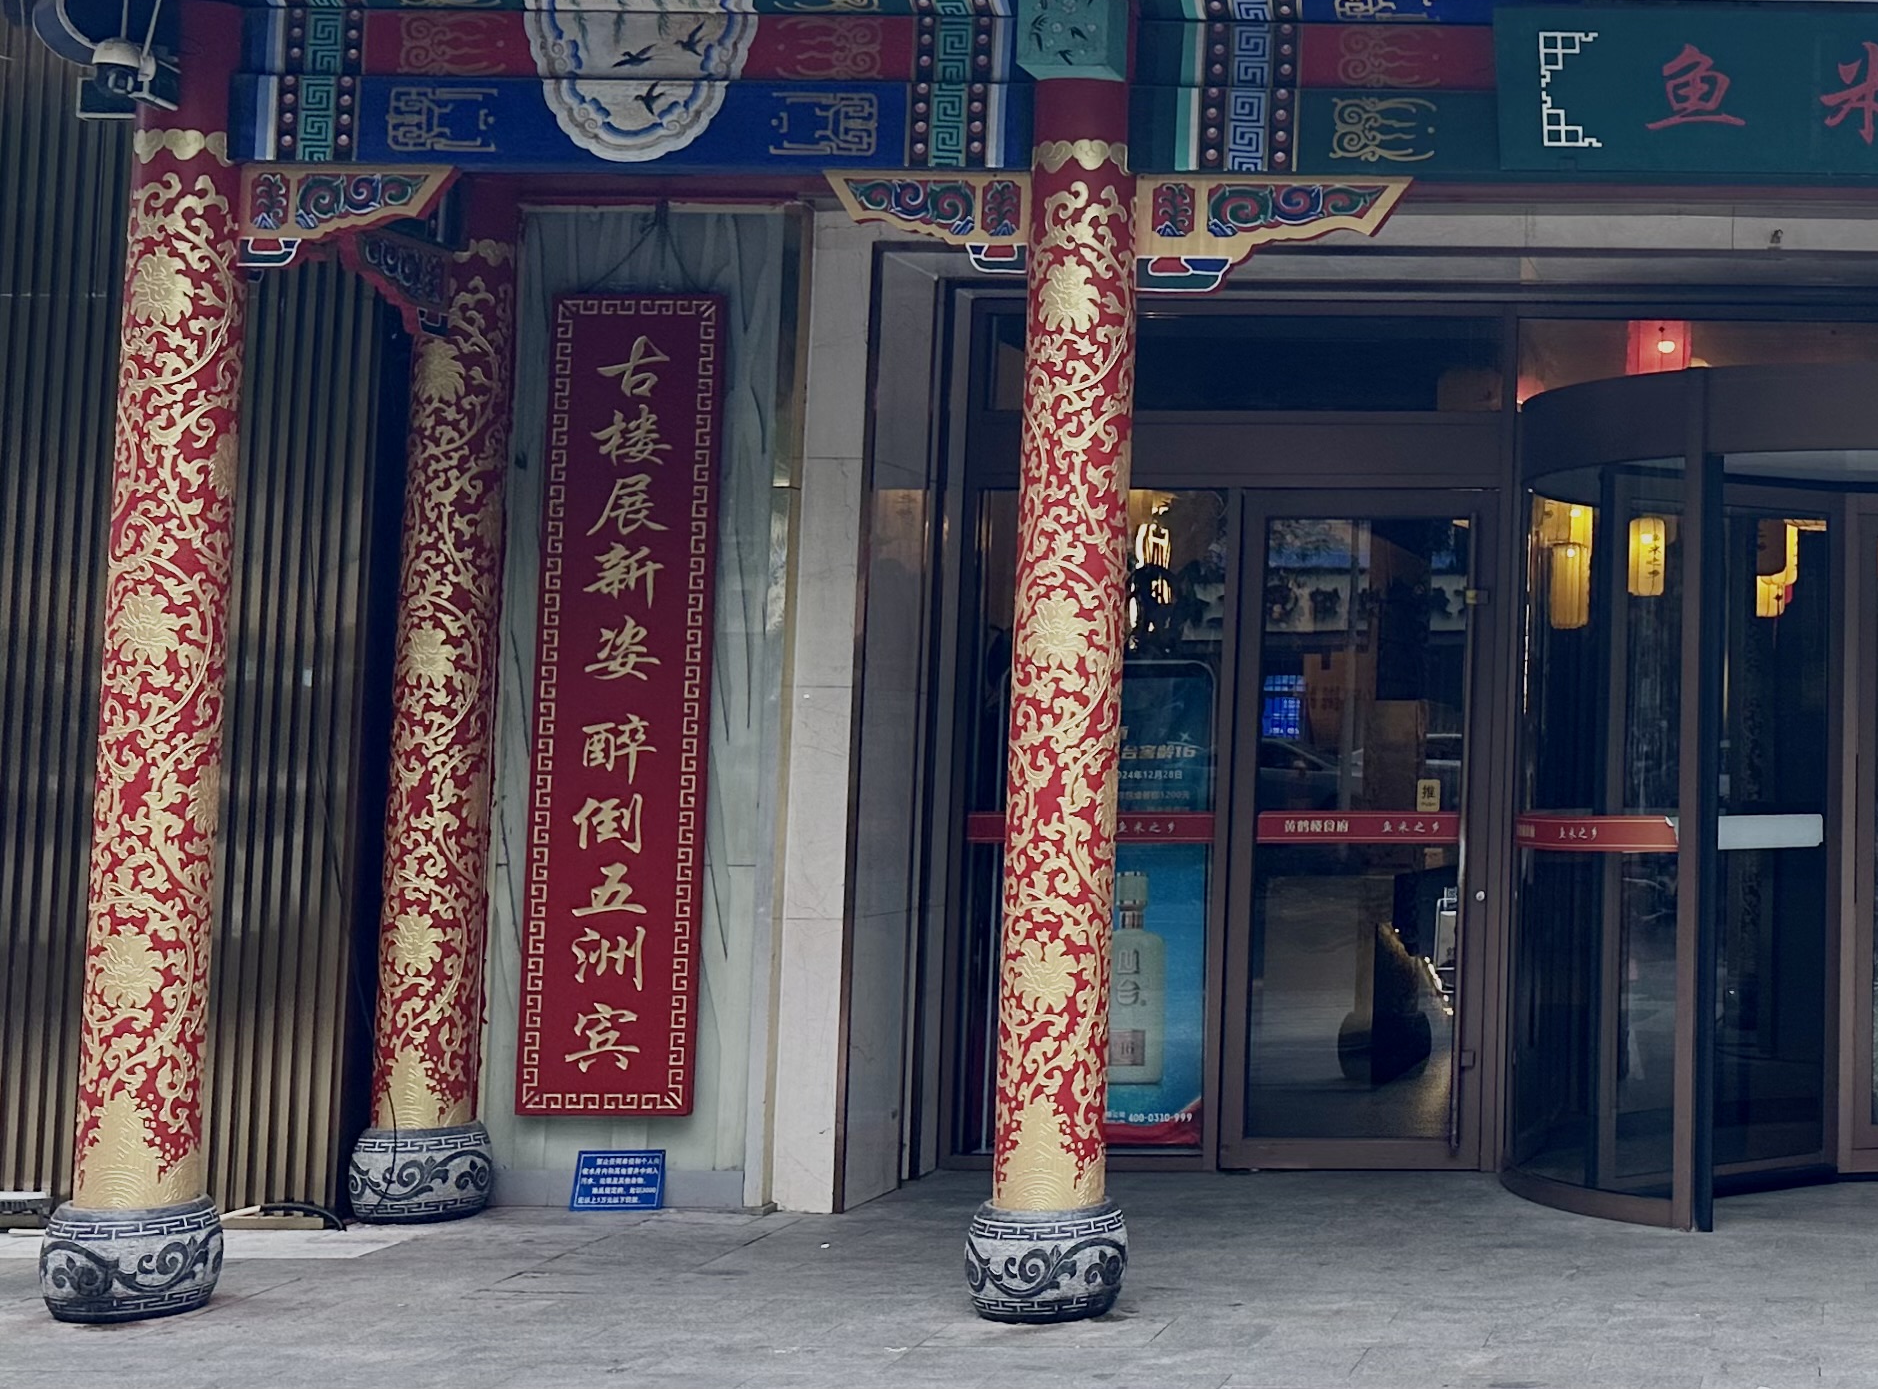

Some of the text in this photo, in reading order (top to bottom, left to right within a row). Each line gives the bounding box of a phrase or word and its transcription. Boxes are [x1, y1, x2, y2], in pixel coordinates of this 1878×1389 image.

[564, 334, 676, 1076] 古楼展新姿 醉倒五洲宾
[1421, 784, 1437, 799] 推
[1117, 820, 1176, 834] 鱼米之乡
[1283, 819, 1441, 834] 黄鹤楼食府 鱼米之乡
